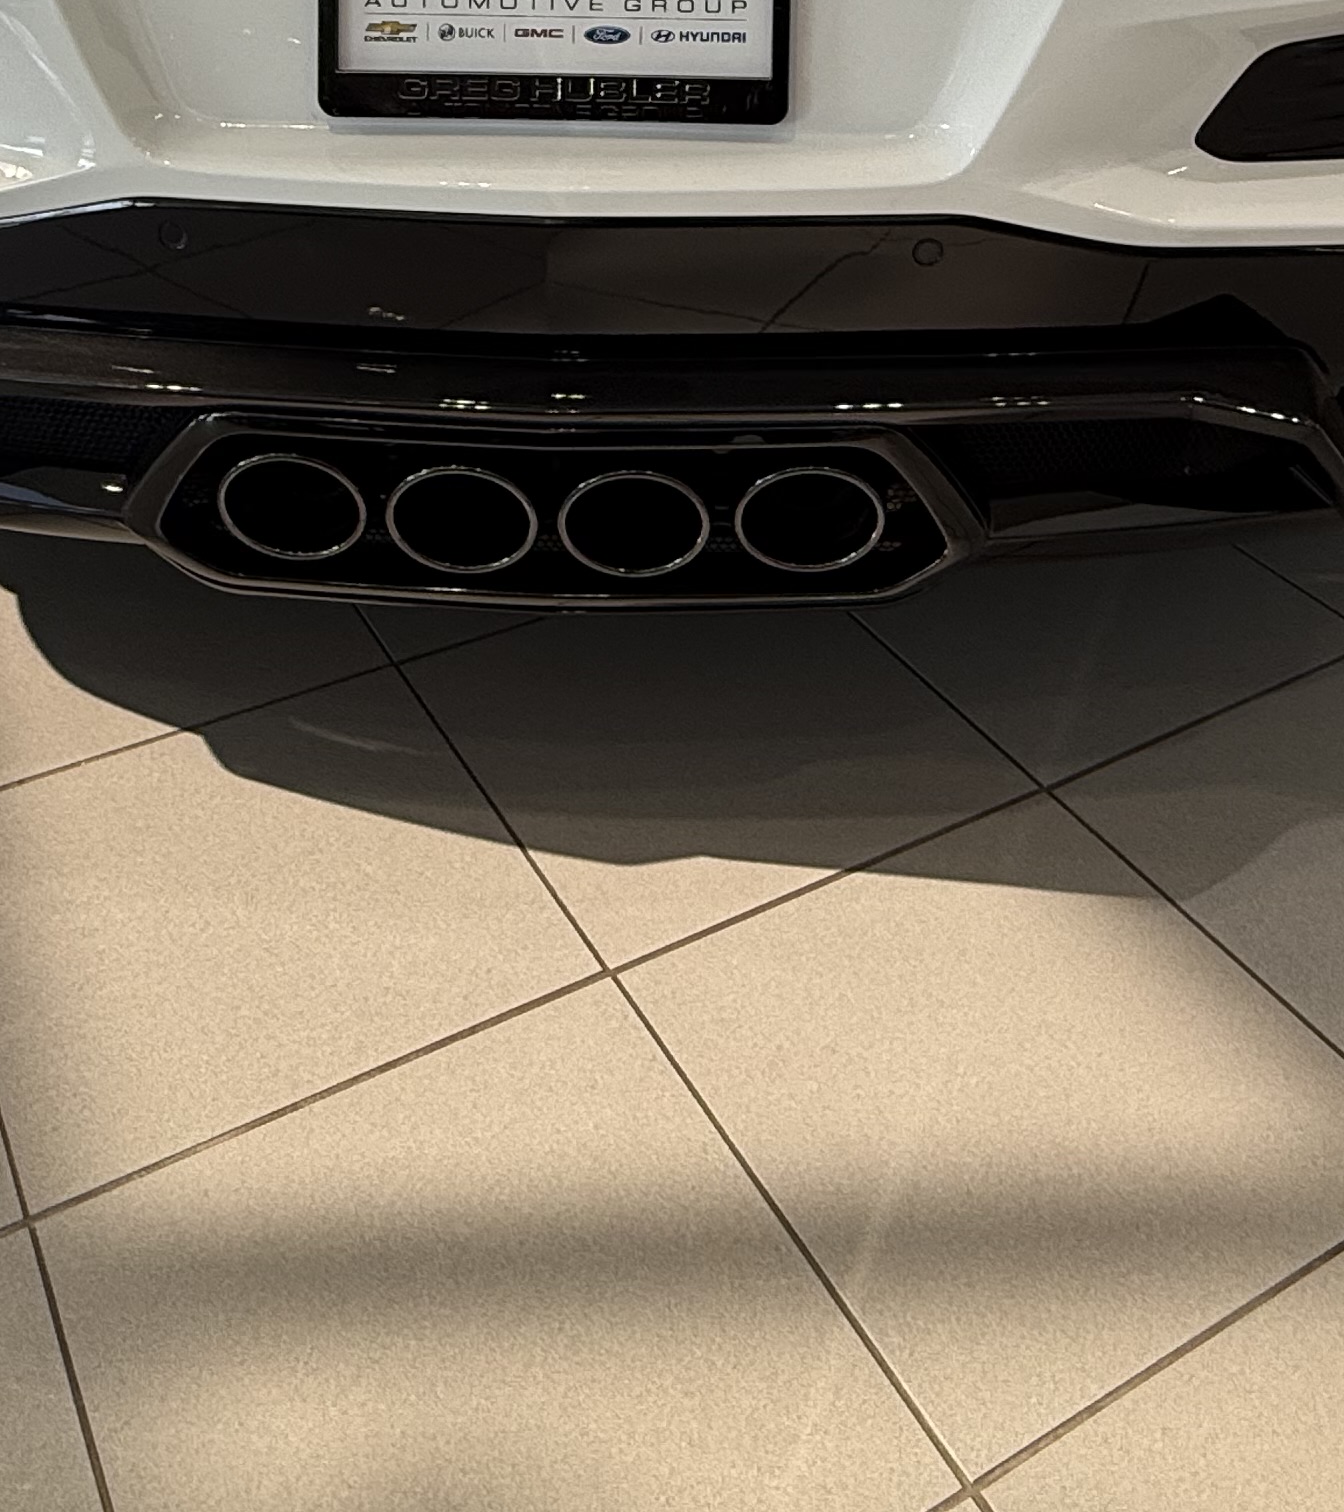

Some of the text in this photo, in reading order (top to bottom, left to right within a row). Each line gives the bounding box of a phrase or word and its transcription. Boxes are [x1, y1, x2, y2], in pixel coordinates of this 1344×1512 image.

[458, 28, 495, 39] BUICK
[514, 28, 564, 38] GMC
[679, 31, 747, 43] HYUNDAI
[530, 77, 710, 104] HUBLER
